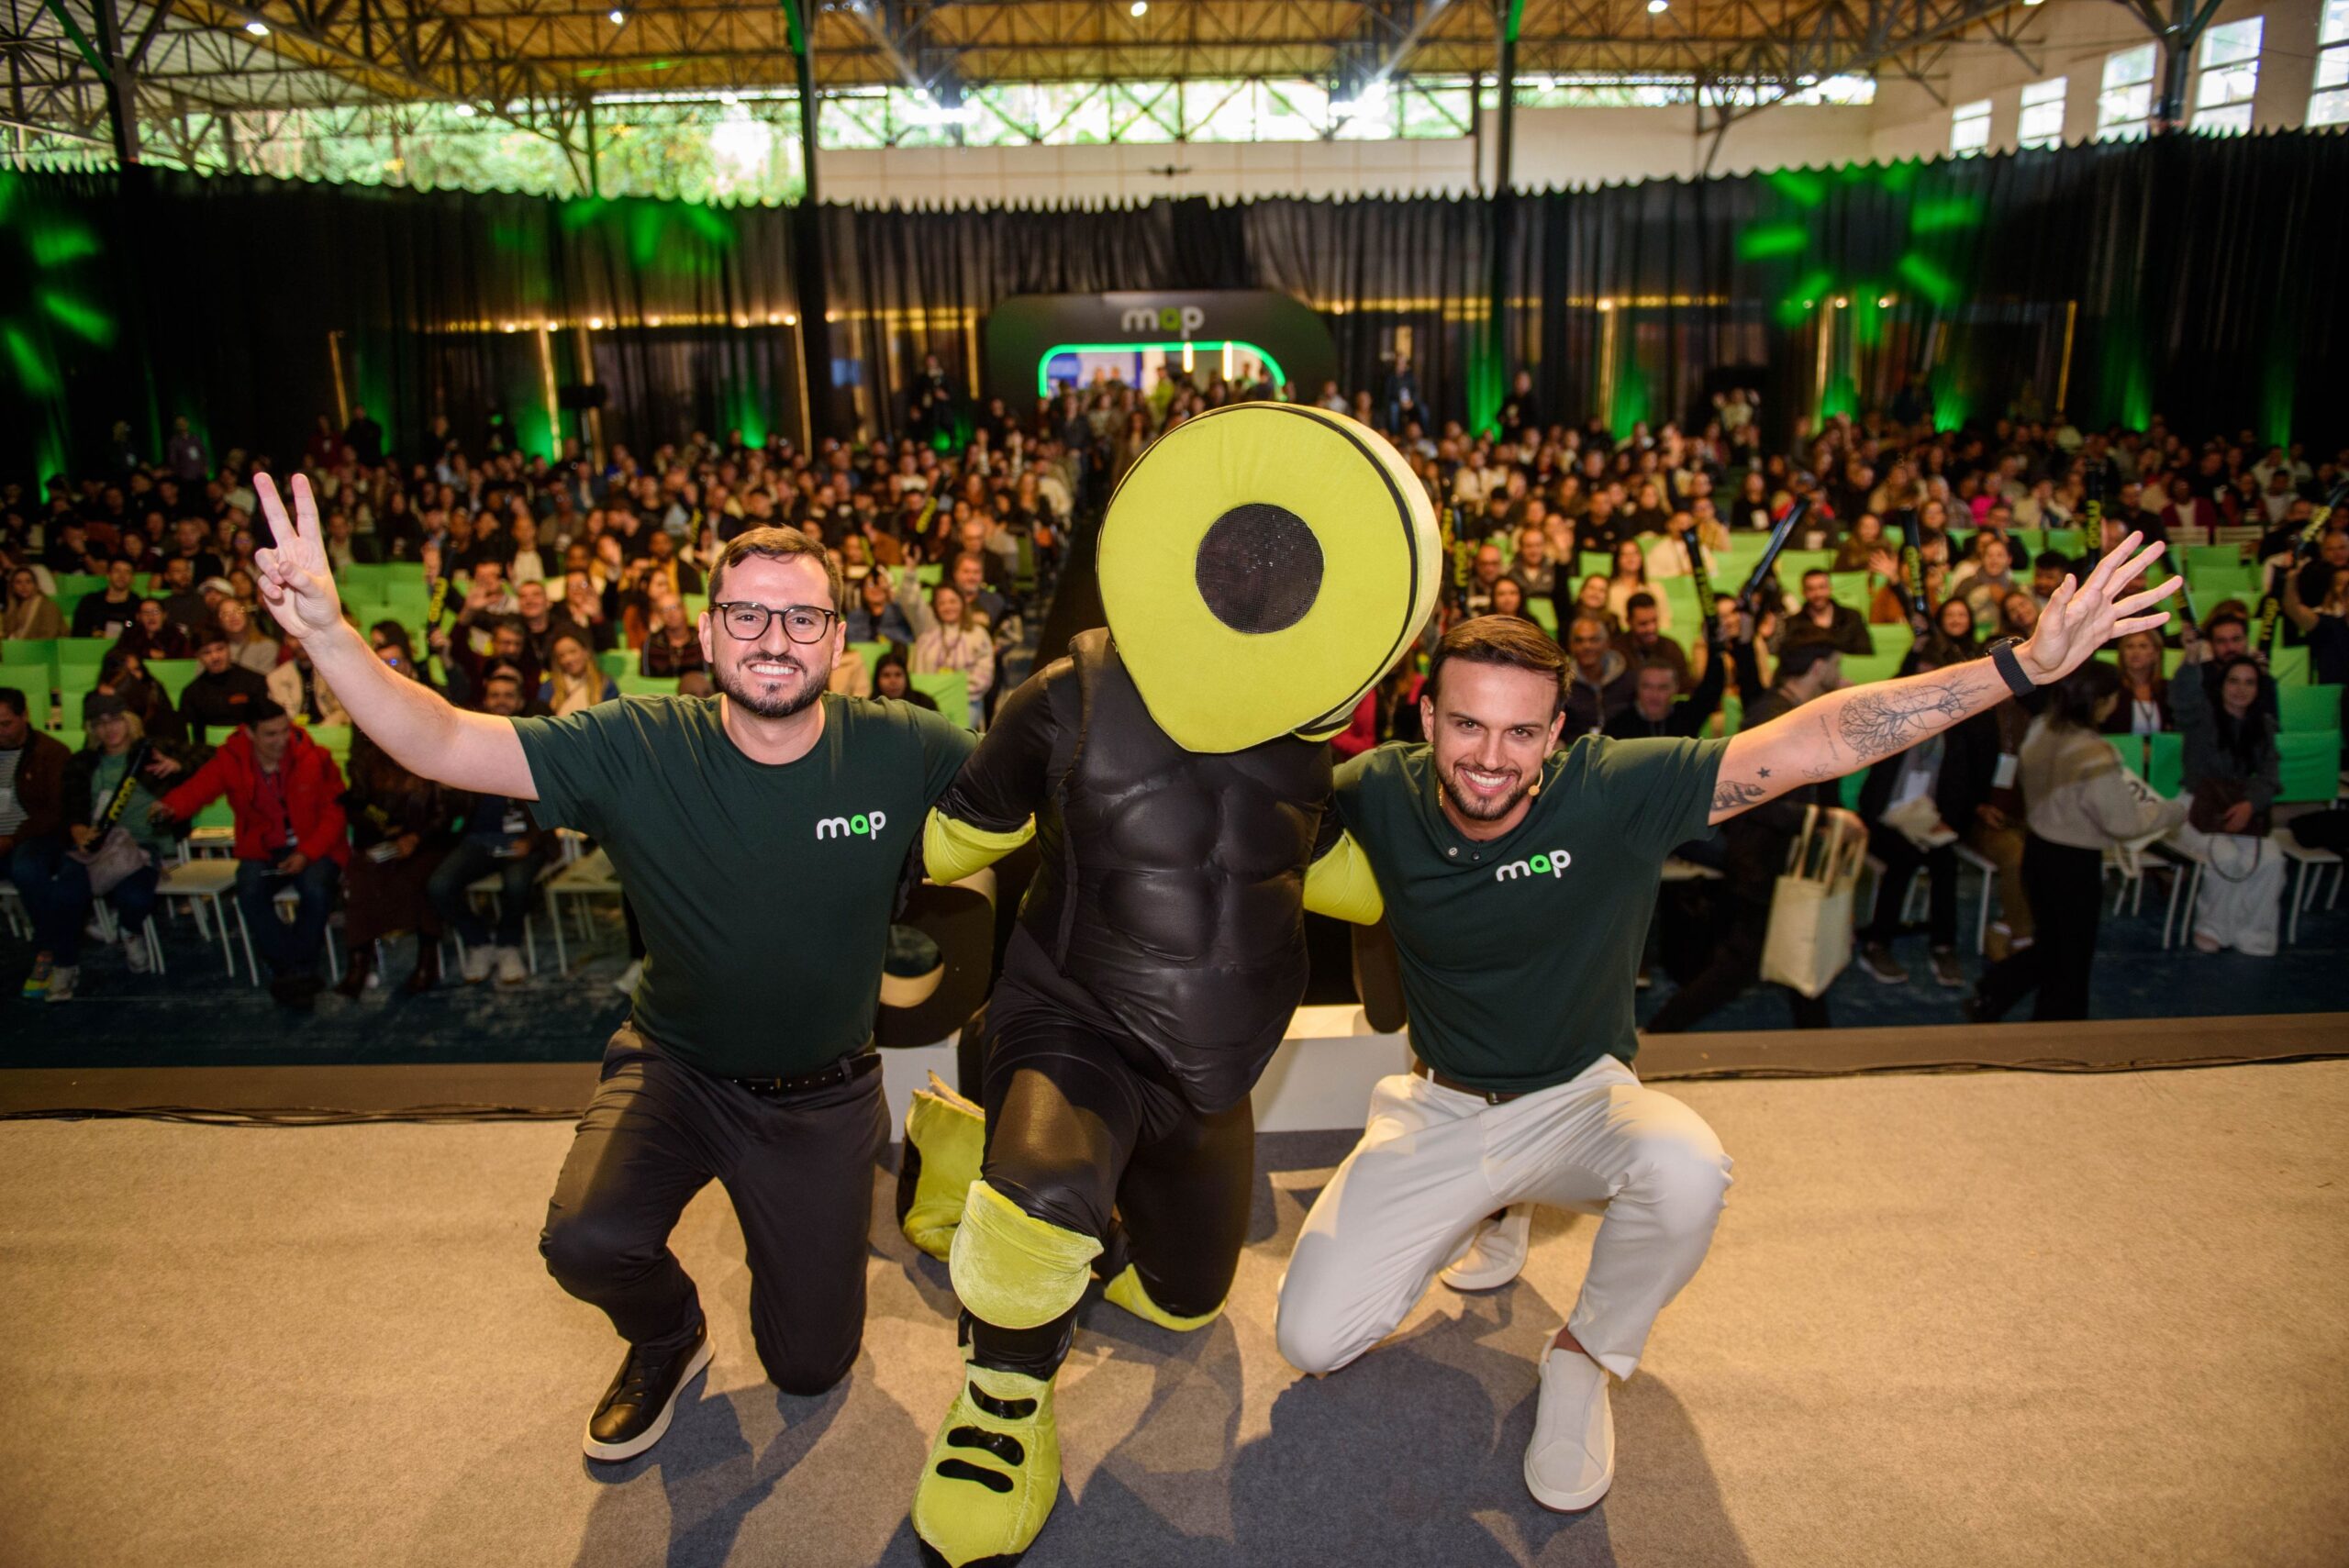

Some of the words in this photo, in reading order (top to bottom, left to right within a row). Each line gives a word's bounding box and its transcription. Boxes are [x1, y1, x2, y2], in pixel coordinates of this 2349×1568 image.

[1121, 306, 1205, 340] map
[816, 810, 886, 840] map
[1496, 850, 1571, 883] map
